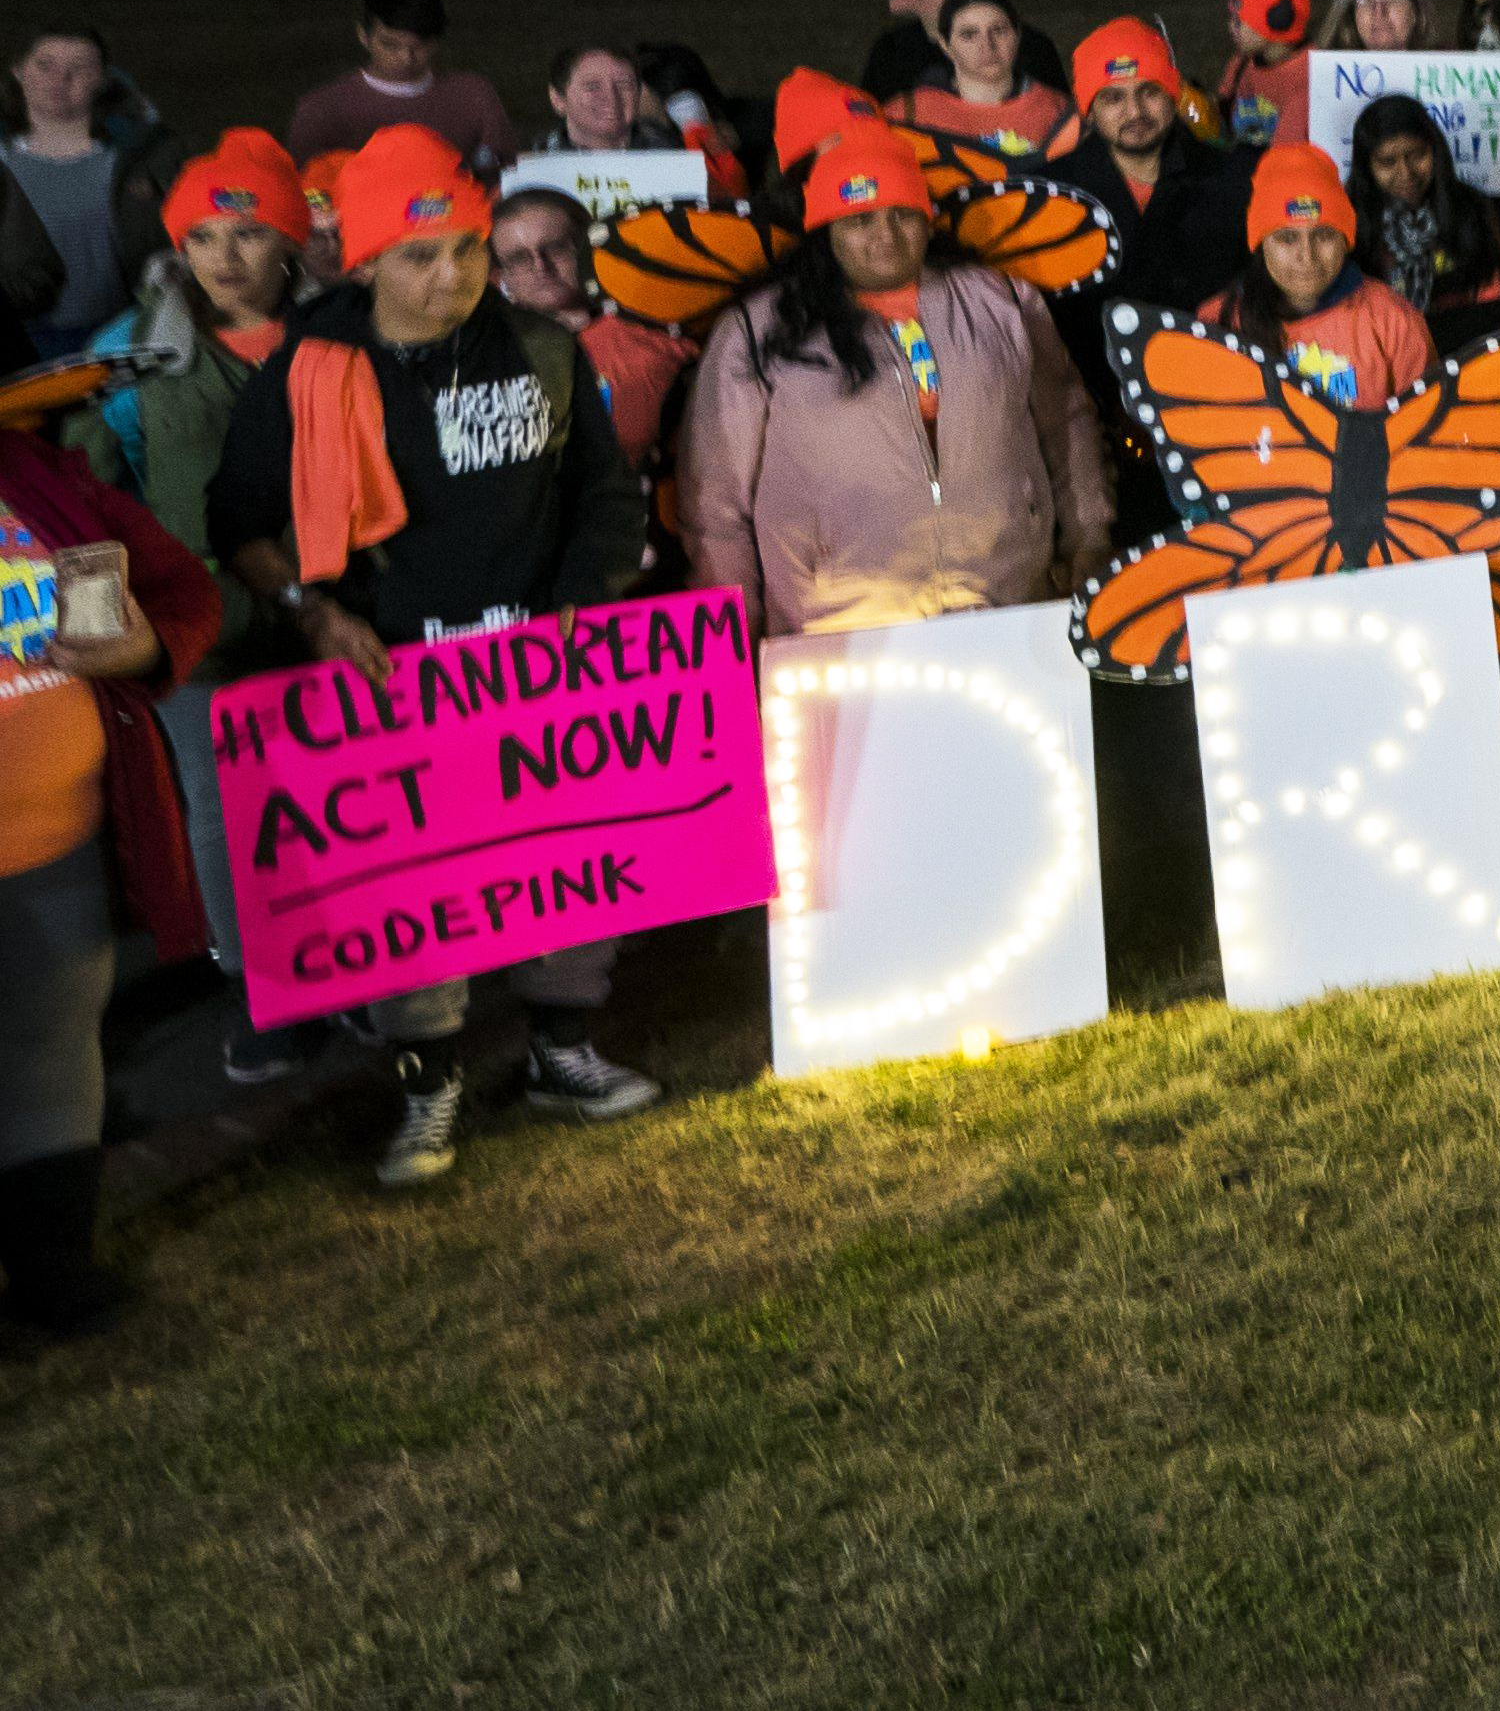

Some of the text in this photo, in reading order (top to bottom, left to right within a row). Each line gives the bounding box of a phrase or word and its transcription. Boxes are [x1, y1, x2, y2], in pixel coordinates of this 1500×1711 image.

[1334, 61, 1385, 101] NO
[214, 600, 747, 766] #CLEANDREAM
[253, 760, 433, 870] ACT
[292, 853, 645, 981] CODEPINK
